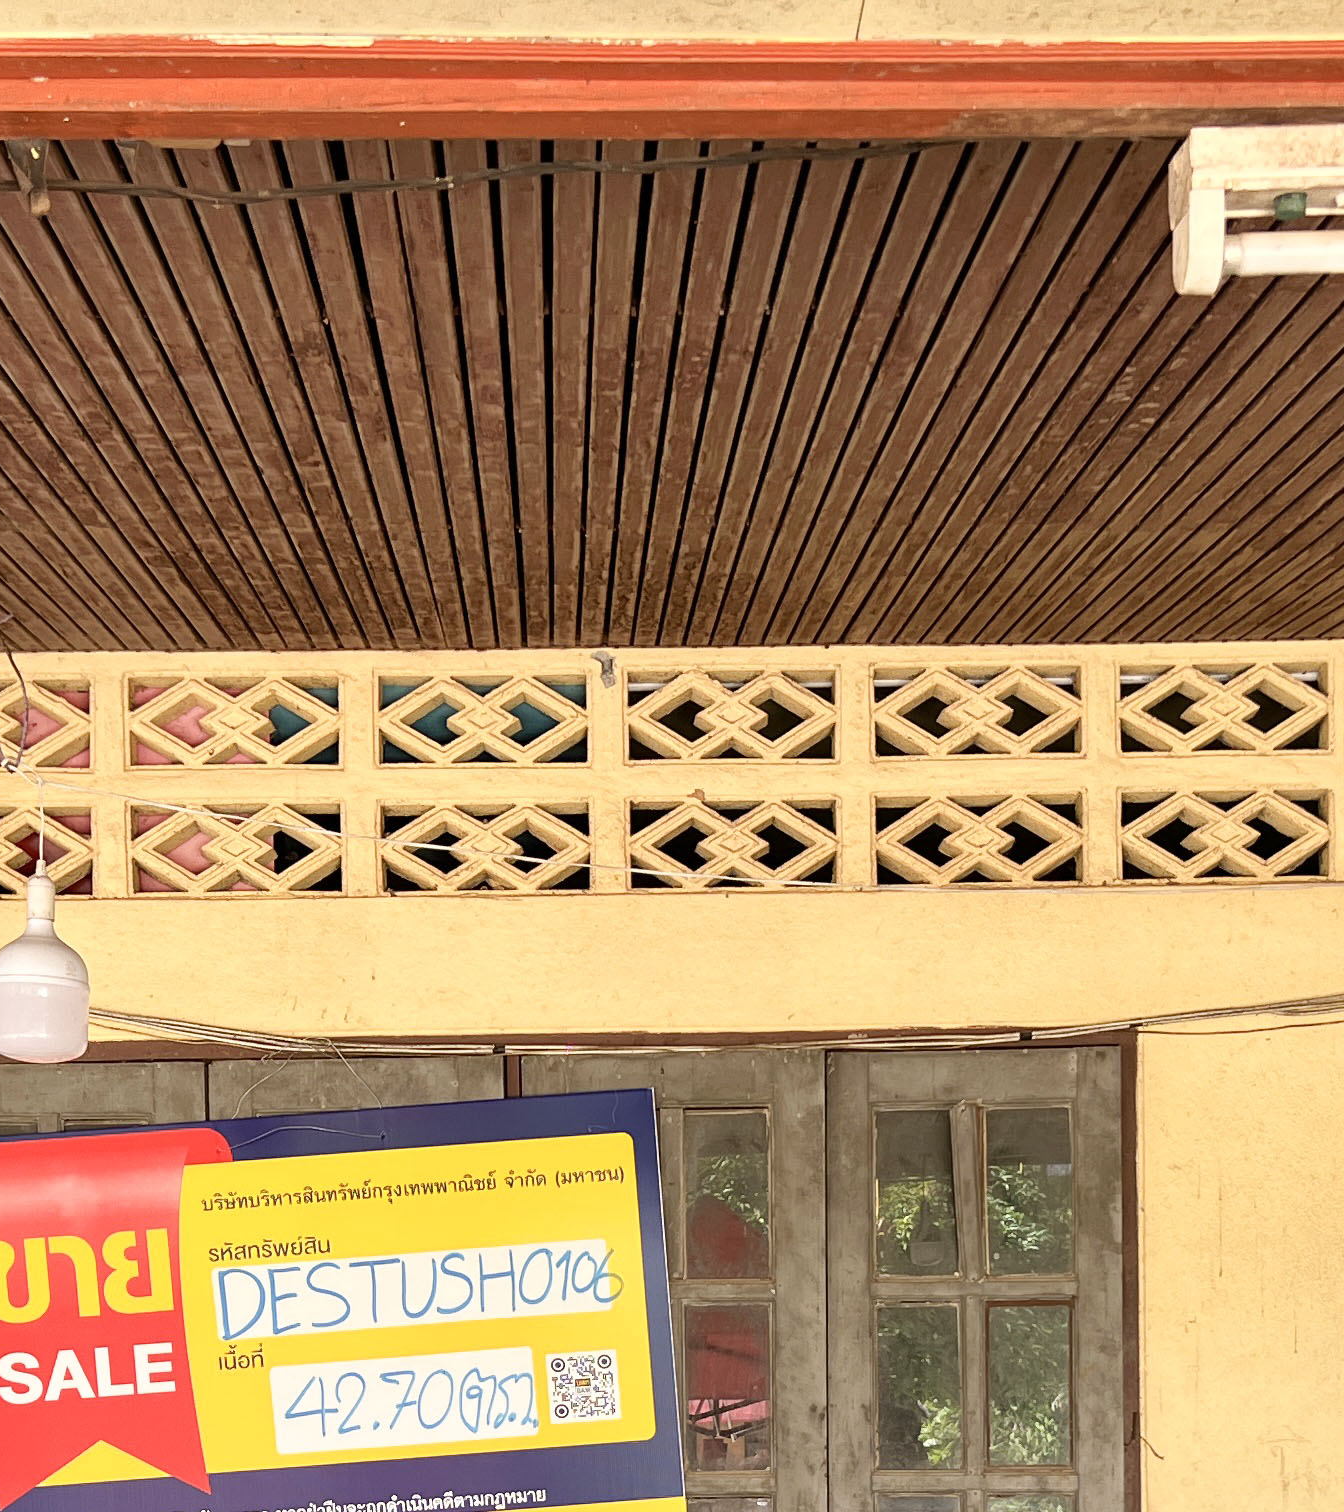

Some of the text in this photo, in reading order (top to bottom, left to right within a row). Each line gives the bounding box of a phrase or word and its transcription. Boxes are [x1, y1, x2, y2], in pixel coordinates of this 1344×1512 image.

[503, 1168, 547, 1189] จำกัด
[555, 1165, 625, 1188] (มหาชน)
[208, 1236, 332, 1263] รหัสทรัพย์สิน
[218, 1342, 265, 1371] เนื้อที่
